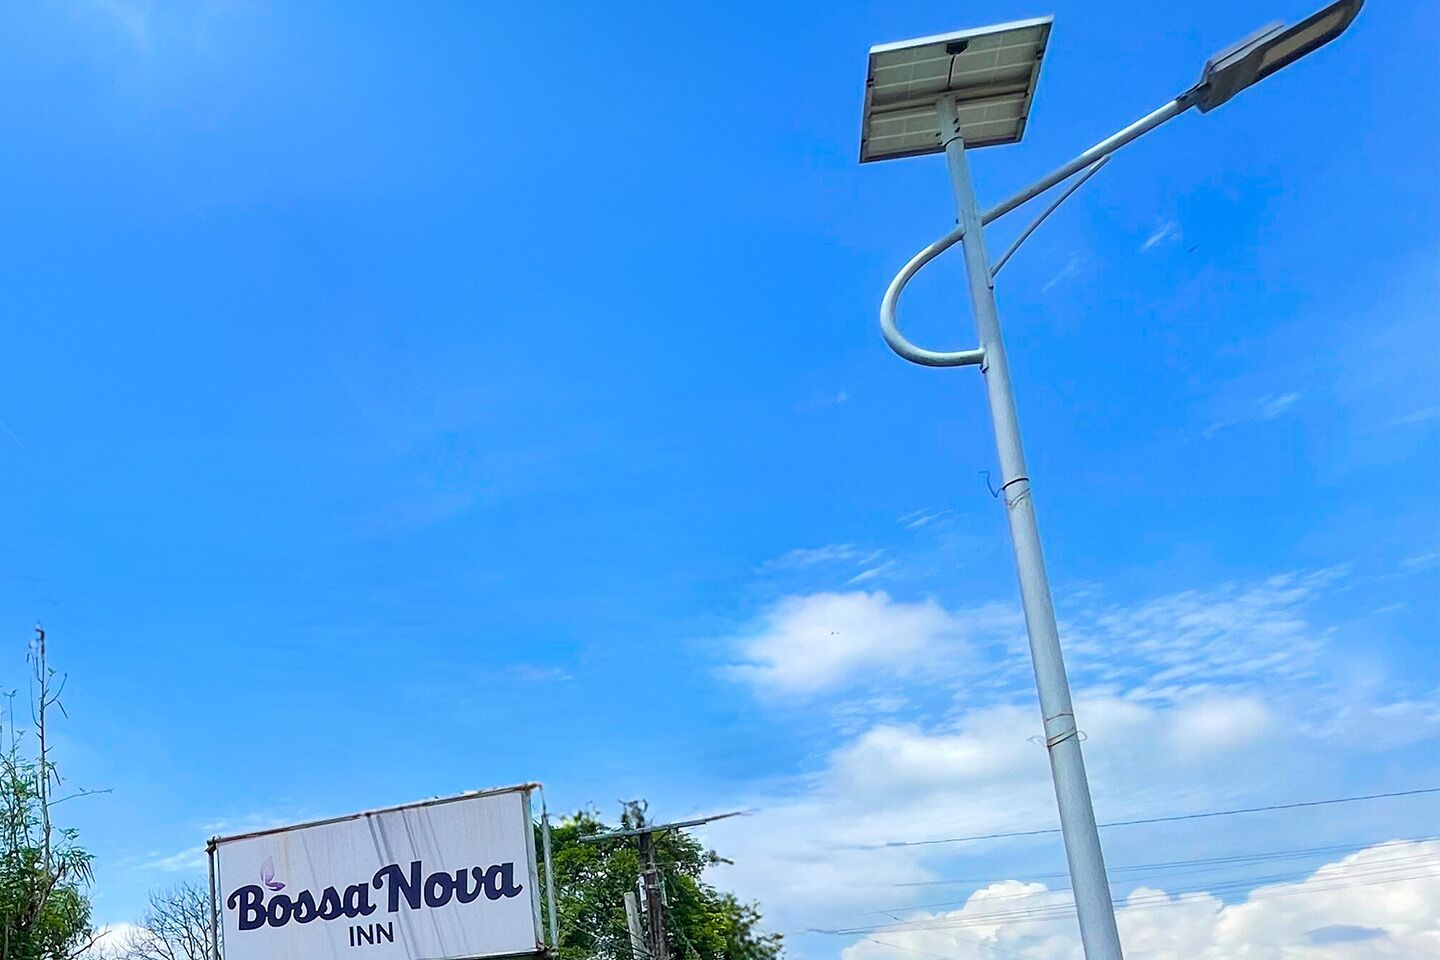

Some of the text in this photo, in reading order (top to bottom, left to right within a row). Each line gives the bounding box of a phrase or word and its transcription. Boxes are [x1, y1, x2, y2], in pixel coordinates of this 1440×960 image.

[227, 860, 523, 931] Bossa Nova
[348, 921, 395, 947] INN
